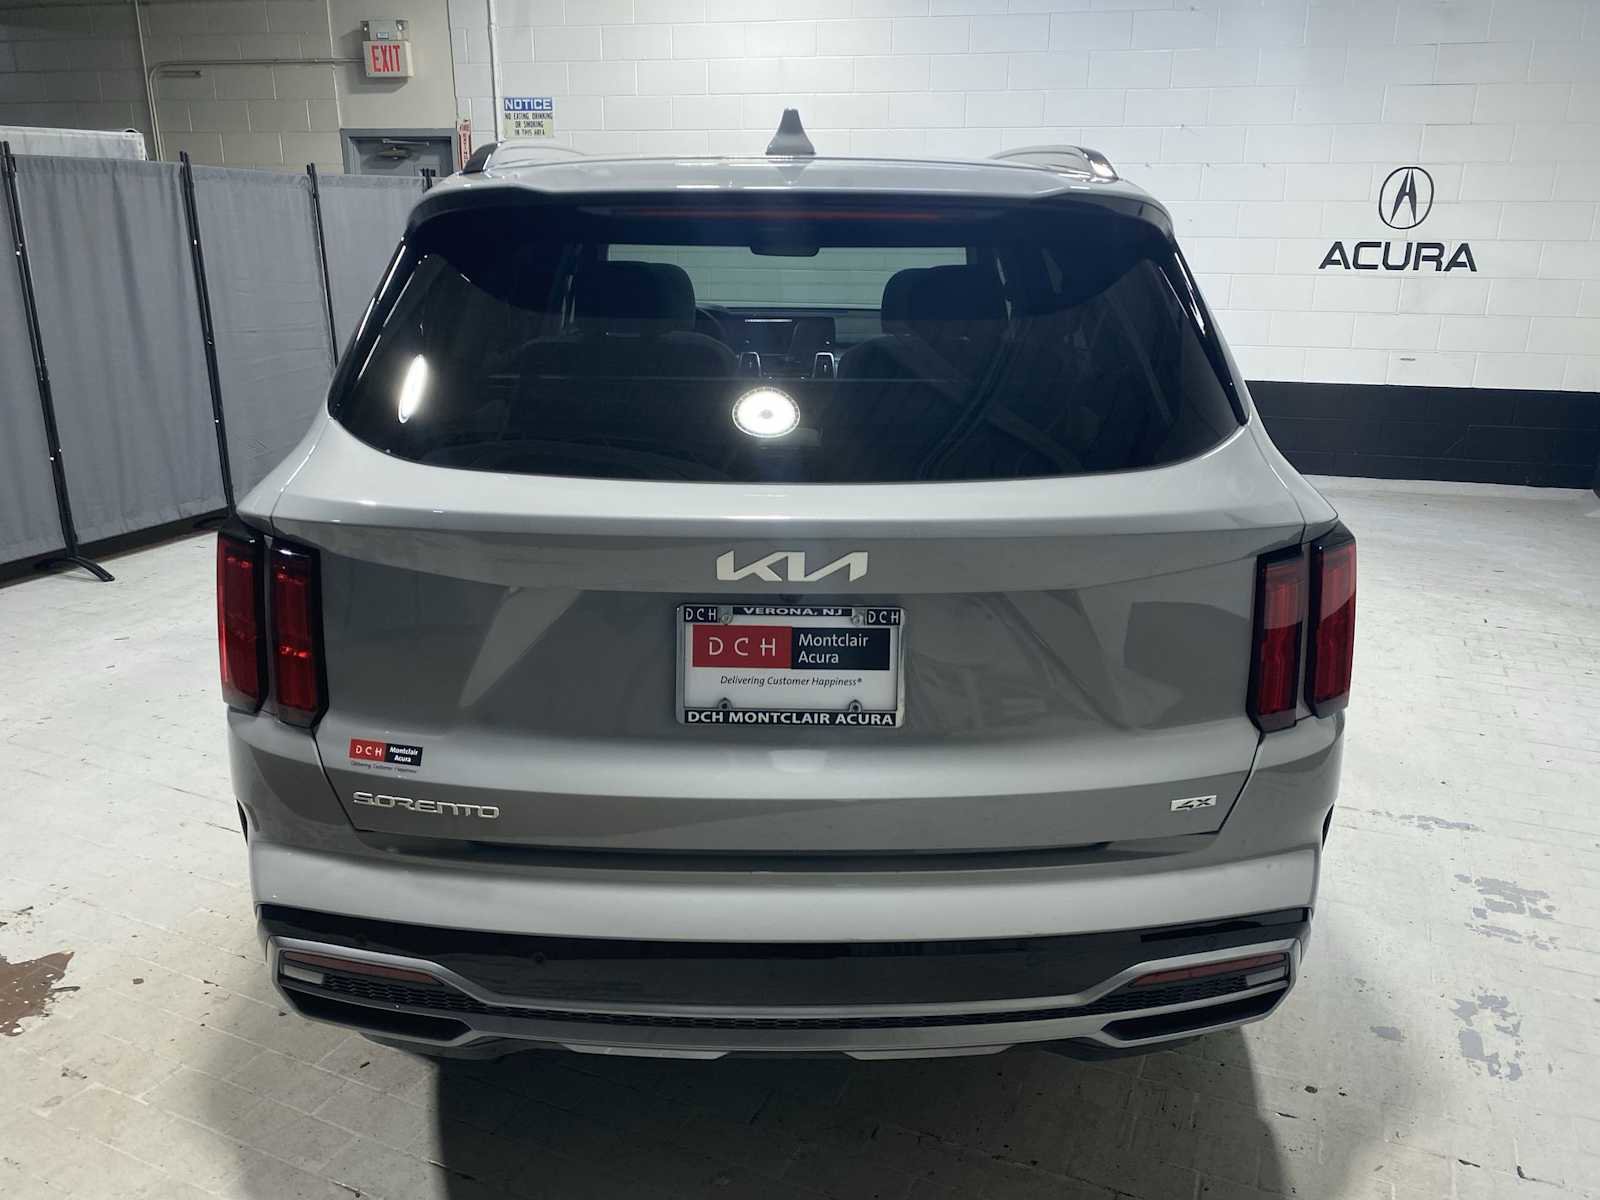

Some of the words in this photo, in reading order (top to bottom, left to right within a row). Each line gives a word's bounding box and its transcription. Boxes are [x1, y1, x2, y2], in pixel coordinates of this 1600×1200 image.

[371, 45, 400, 72] EXIT
[505, 98, 551, 110] NOTICE
[505, 112, 511, 120] NO
[515, 120, 521, 128] OR
[523, 120, 544, 128] SMOKING
[1319, 241, 1477, 272] ACURA
[716, 551, 868, 582] KIA
[685, 608, 717, 621] DCH
[822, 608, 843, 616] NJ
[868, 611, 900, 624] DCH
[708, 637, 776, 657] DCH
[798, 634, 869, 647] Montclair
[798, 651, 839, 664] Acura
[720, 675, 765, 687] Delivering
[767, 676, 809, 686] Customer
[686, 711, 724, 723] DCH
[728, 712, 830, 724] MONTCLAIR
[835, 713, 894, 725] ACURA
[355, 745, 383, 757] DCH
[389, 746, 418, 755] Montclair
[394, 754, 412, 763] Acura
[353, 791, 500, 819] SORENTO
